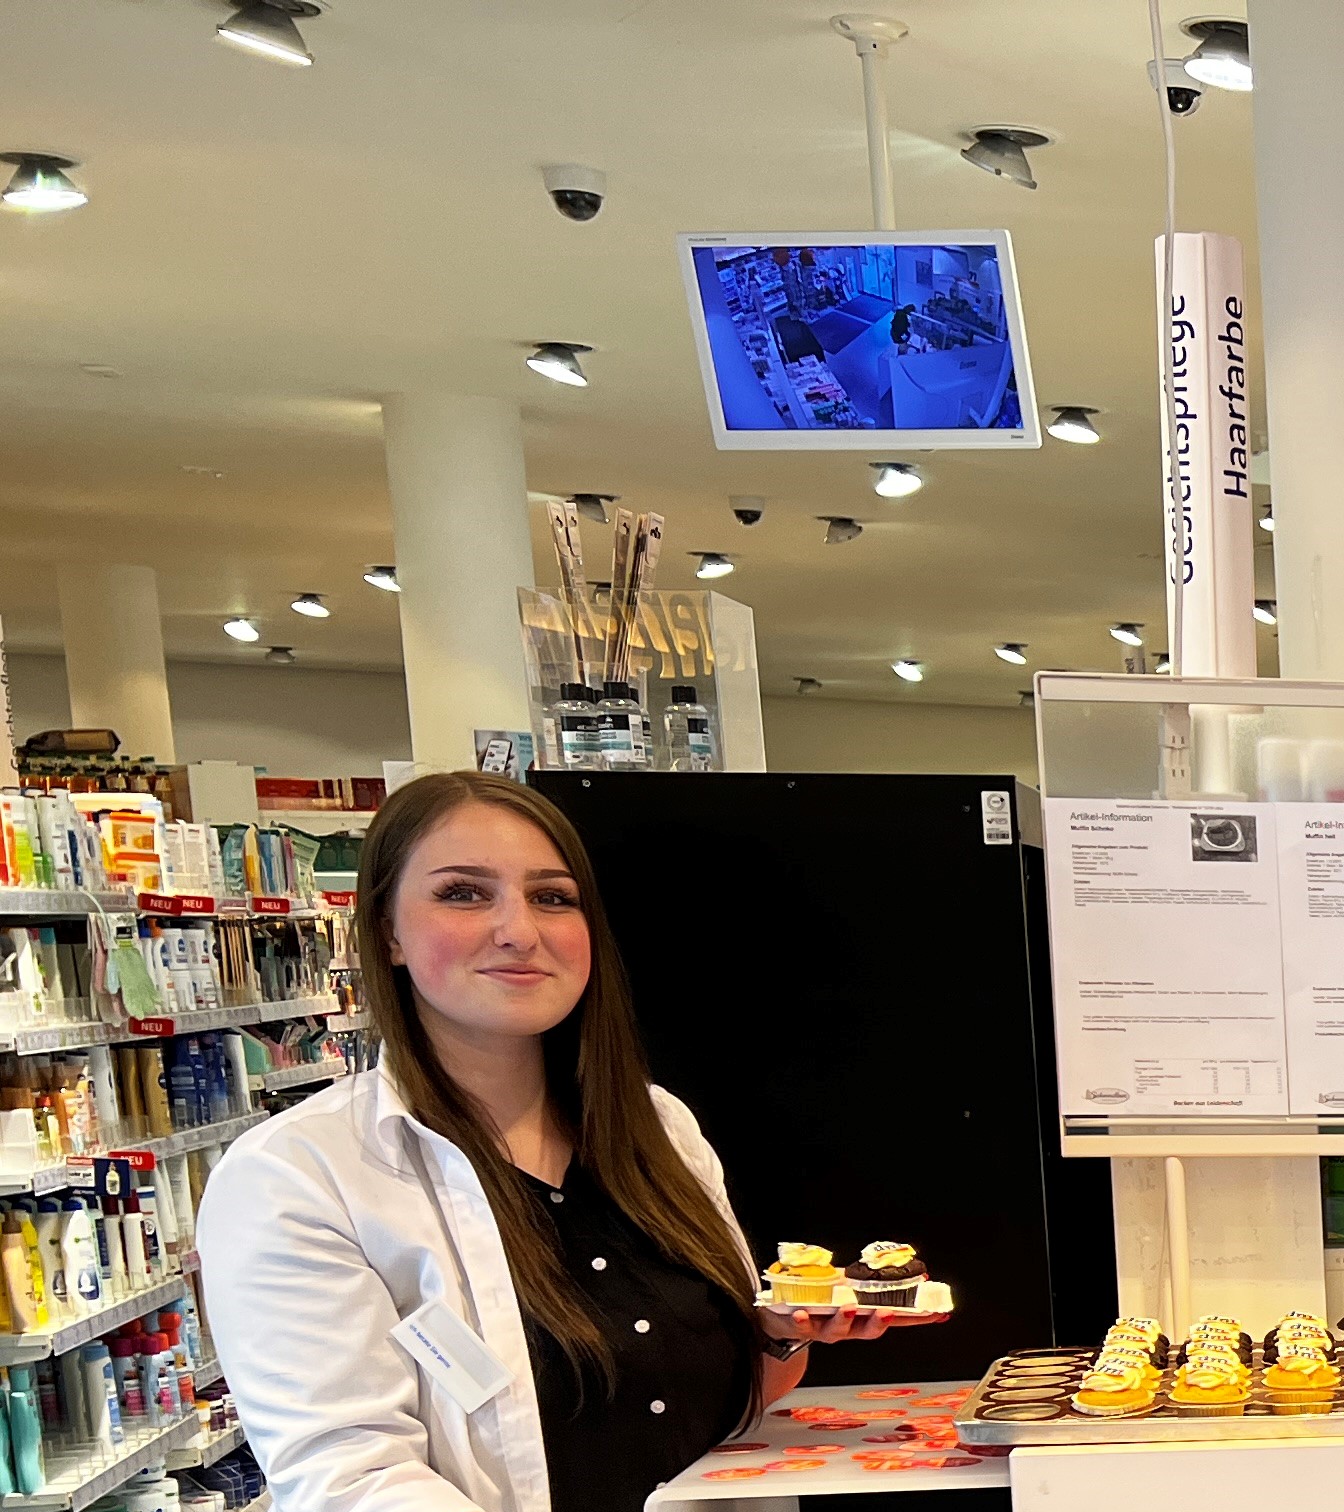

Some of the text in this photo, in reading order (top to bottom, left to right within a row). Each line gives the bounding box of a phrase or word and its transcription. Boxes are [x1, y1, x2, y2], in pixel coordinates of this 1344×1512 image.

[1217, 295, 1248, 500] Haarfarbe
[1069, 811, 1153, 823] Artikel-Information
[150, 898, 172, 910] NEU
[182, 899, 203, 909] NEU
[261, 901, 281, 910] NEU
[141, 1022, 163, 1033] NEU
